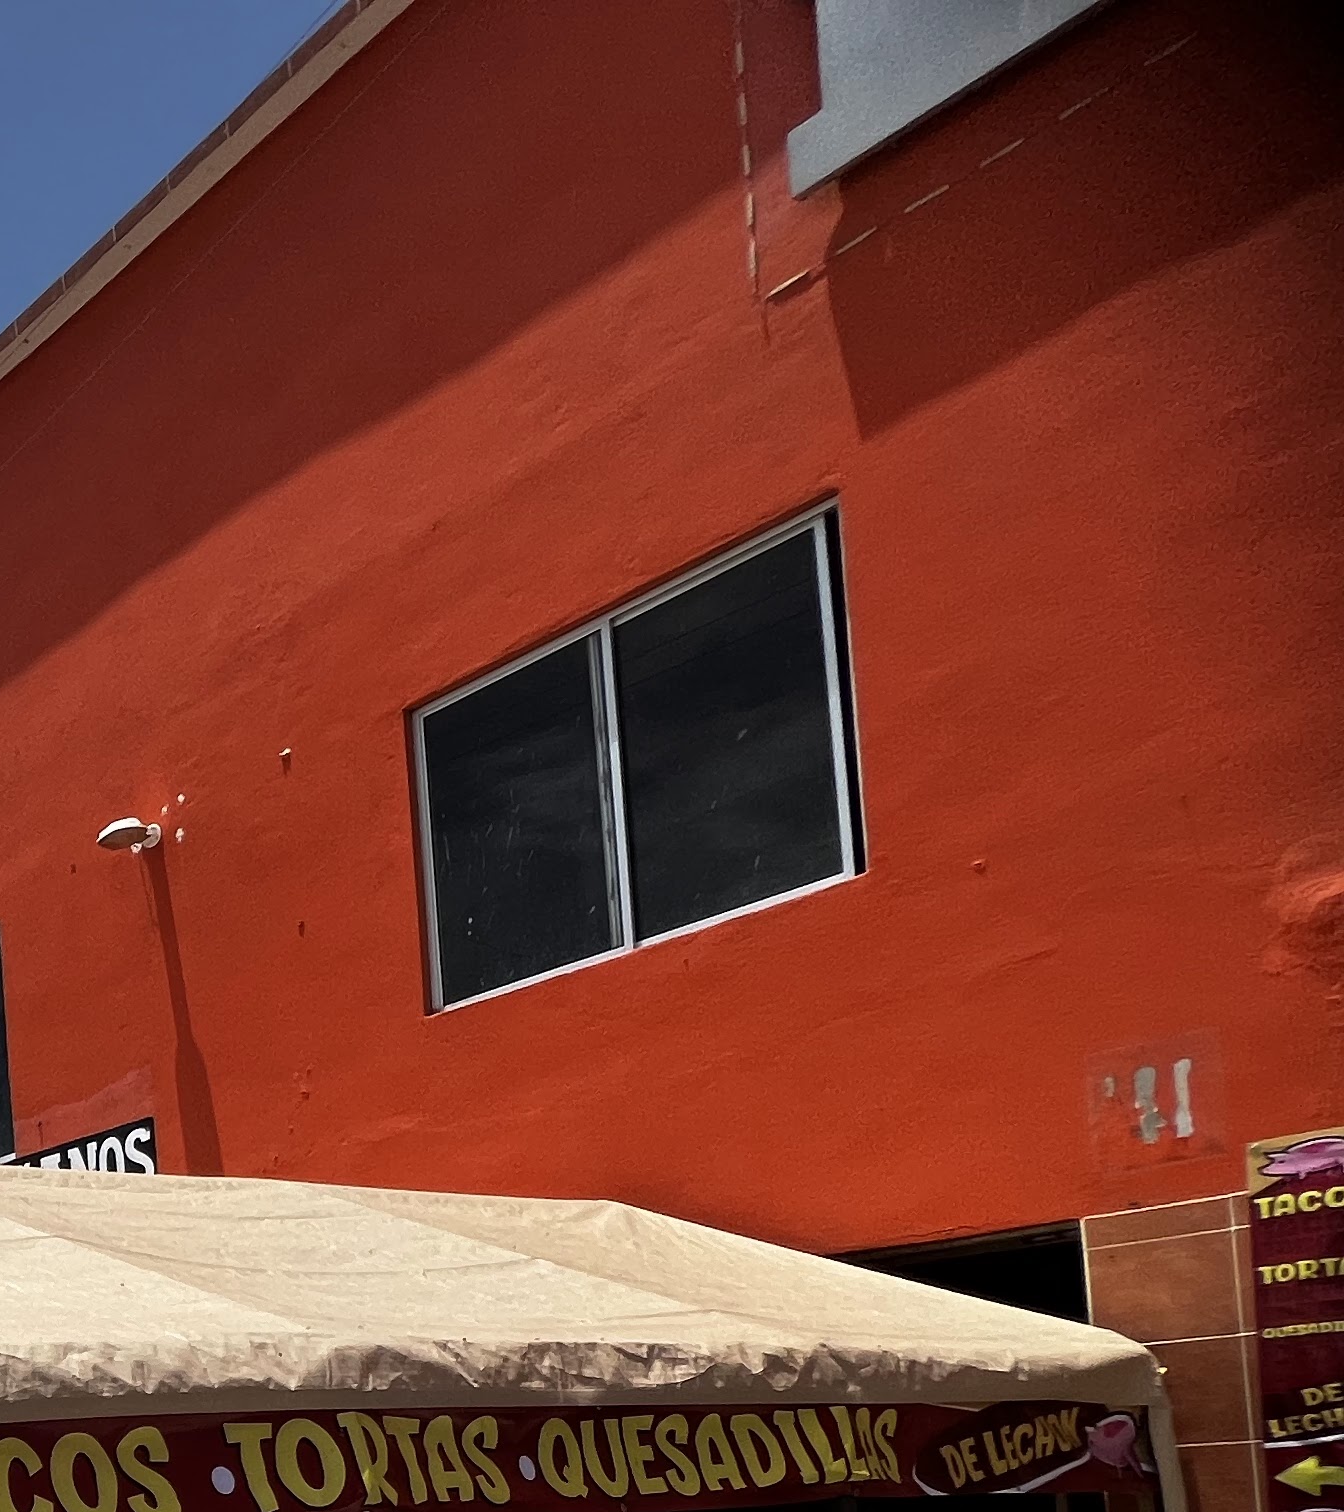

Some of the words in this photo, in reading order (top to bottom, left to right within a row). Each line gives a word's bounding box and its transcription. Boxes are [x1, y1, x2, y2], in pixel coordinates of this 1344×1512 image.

[1253, 1186, 1344, 1219] TACO
[1257, 1258, 1344, 1285] TORT
[1300, 1382, 1343, 1406] DE
[1266, 1407, 1344, 1439] LECH
[536, 1406, 900, 1498] QUESADILLAS
[939, 1437, 986, 1489] DE
